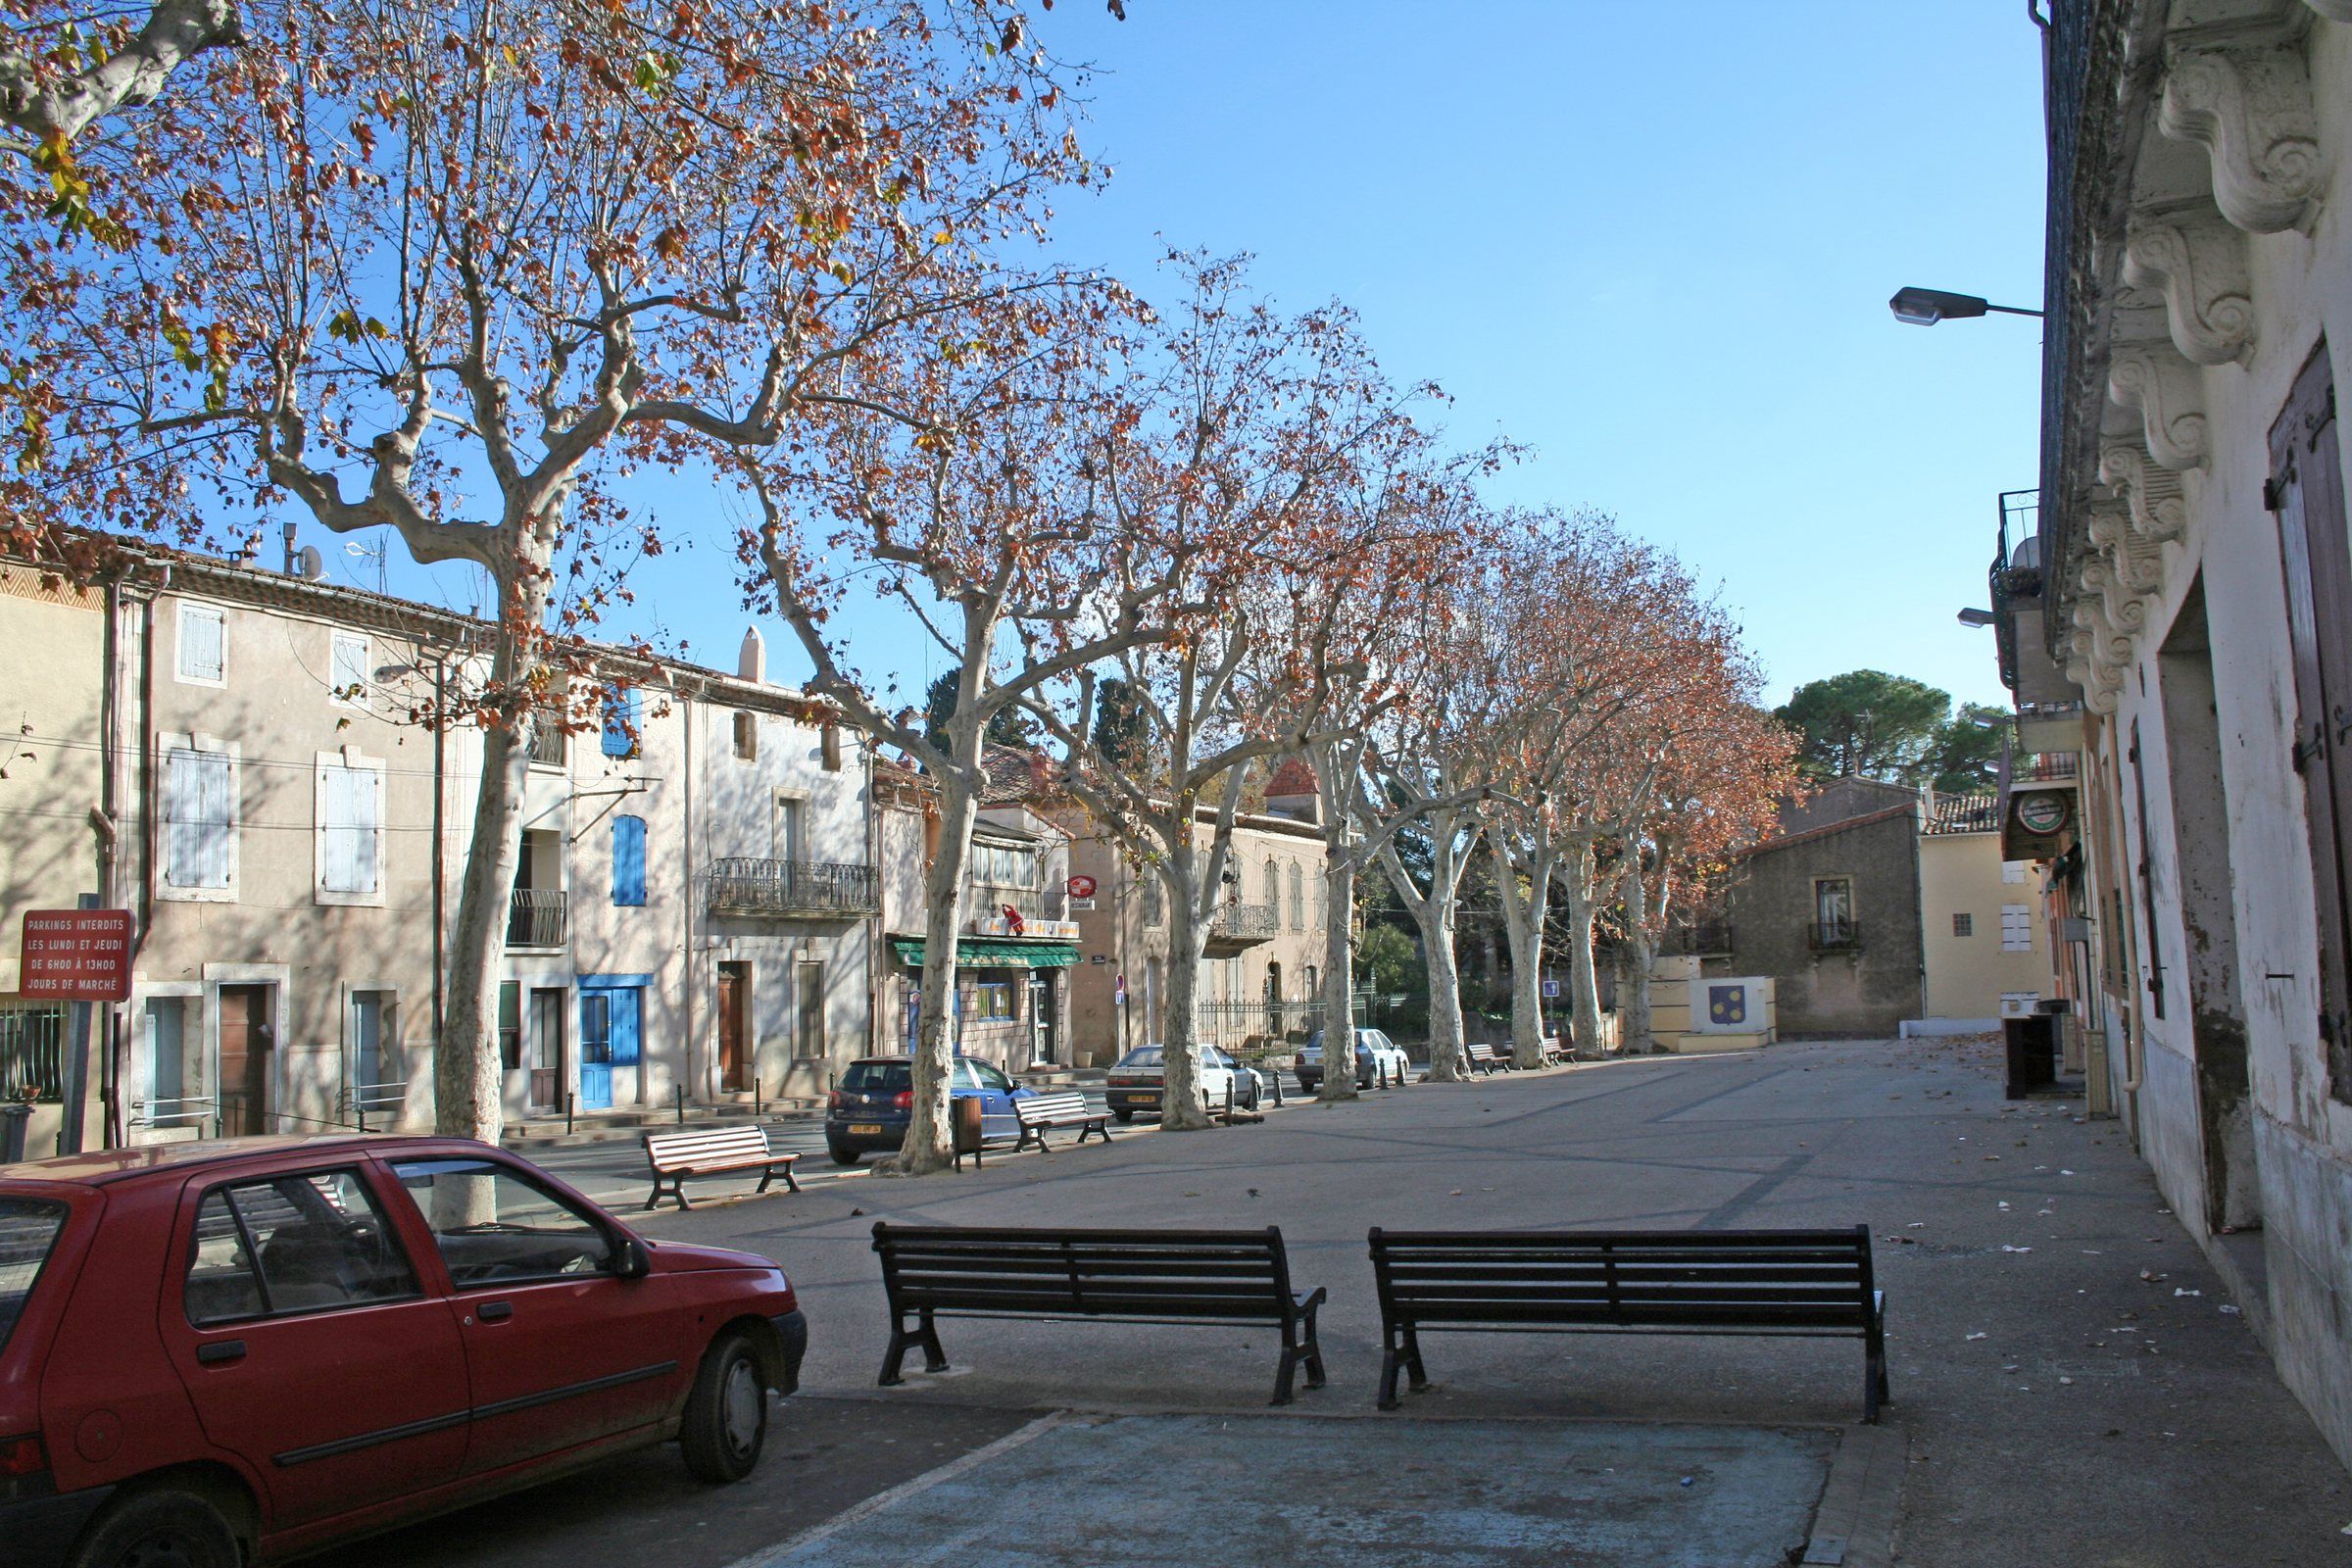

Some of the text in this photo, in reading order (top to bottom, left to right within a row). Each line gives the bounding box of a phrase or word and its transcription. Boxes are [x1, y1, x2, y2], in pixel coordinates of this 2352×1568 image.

[27, 919, 123, 930] PARKINGS INTERDITS
[27, 940, 122, 951] LES LUNDI ET JEUDI
[31, 957, 116, 970] DE 6H00 À 13H00
[27, 978, 117, 991] JOURS DE MARCHÉ
